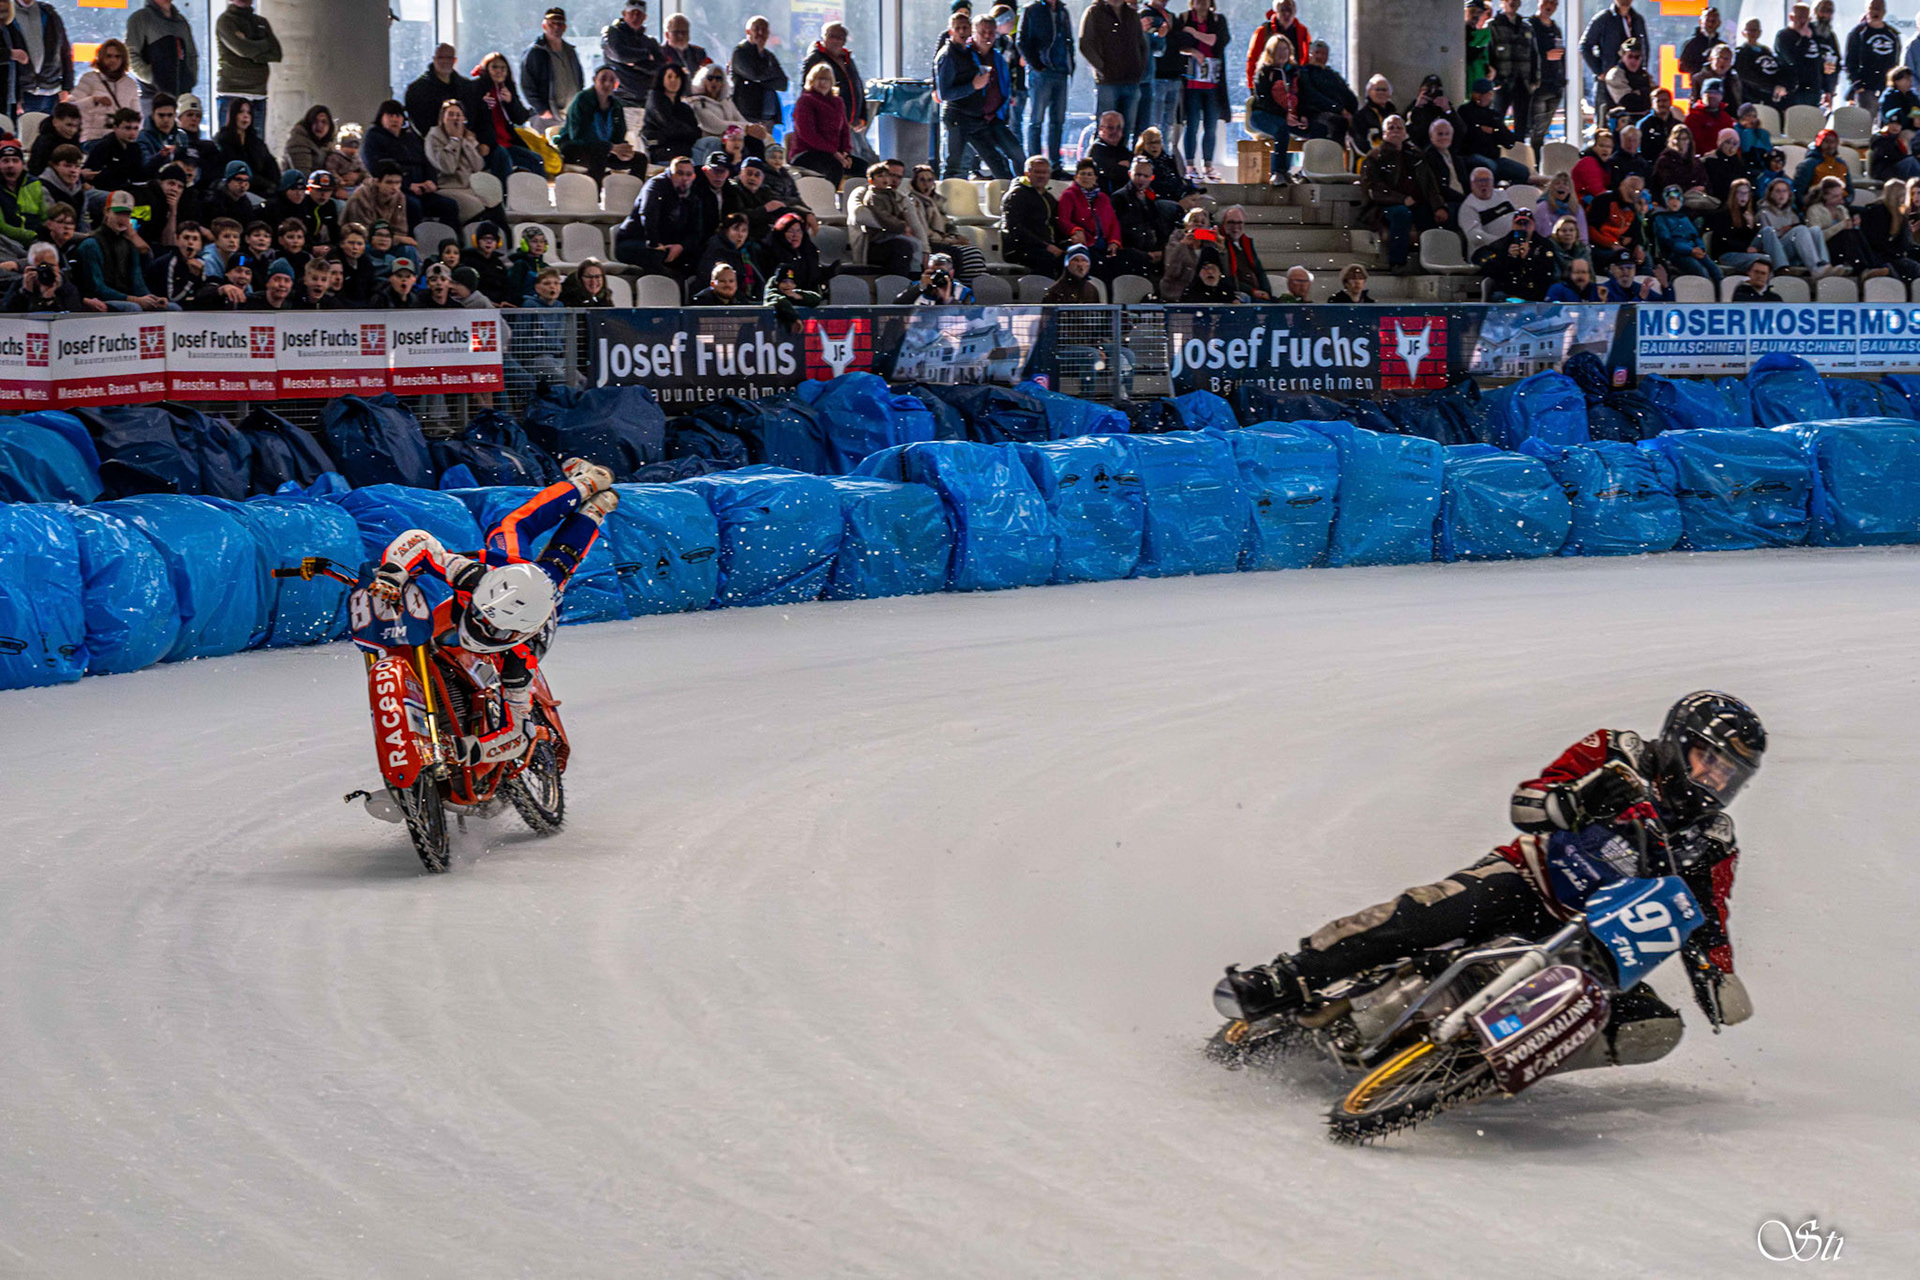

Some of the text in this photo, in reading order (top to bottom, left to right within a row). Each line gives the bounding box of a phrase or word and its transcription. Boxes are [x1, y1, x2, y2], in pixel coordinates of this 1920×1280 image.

[1640, 309, 1746, 336] MOSER
[1750, 309, 1856, 335] MOSER
[1860, 308, 1920, 335] MOS
[58, 335, 96, 360] Josef
[99, 333, 137, 353] Fuchs
[172, 330, 208, 352] Josef
[210, 330, 247, 348] Fuchs
[282, 329, 318, 351] Josef
[320, 329, 358, 347] Fuchs
[392, 327, 428, 349] Josef
[431, 326, 469, 344] Fuchs
[1640, 341, 1745, 354] BAUMASCHINEN
[1751, 340, 1854, 353] BAUMASCHINEN
[596, 330, 797, 388] Josef Fuchs
[1171, 326, 1371, 378] Josef Fuchs
[58, 380, 166, 399] Menschen. Bauen. Werte.
[172, 378, 276, 391] Menschen. Bauen. Werte.
[282, 375, 386, 389] Menschen. Bauen. Werte.
[392, 372, 499, 386] Menschen. Bauen. Werte.
[1210, 374, 1374, 393] Banternehmen
[650, 382, 797, 402] auunternehm
[380, 625, 407, 640] FIM
[1619, 901, 1681, 953] 97
[1611, 932, 1638, 967] FIM
